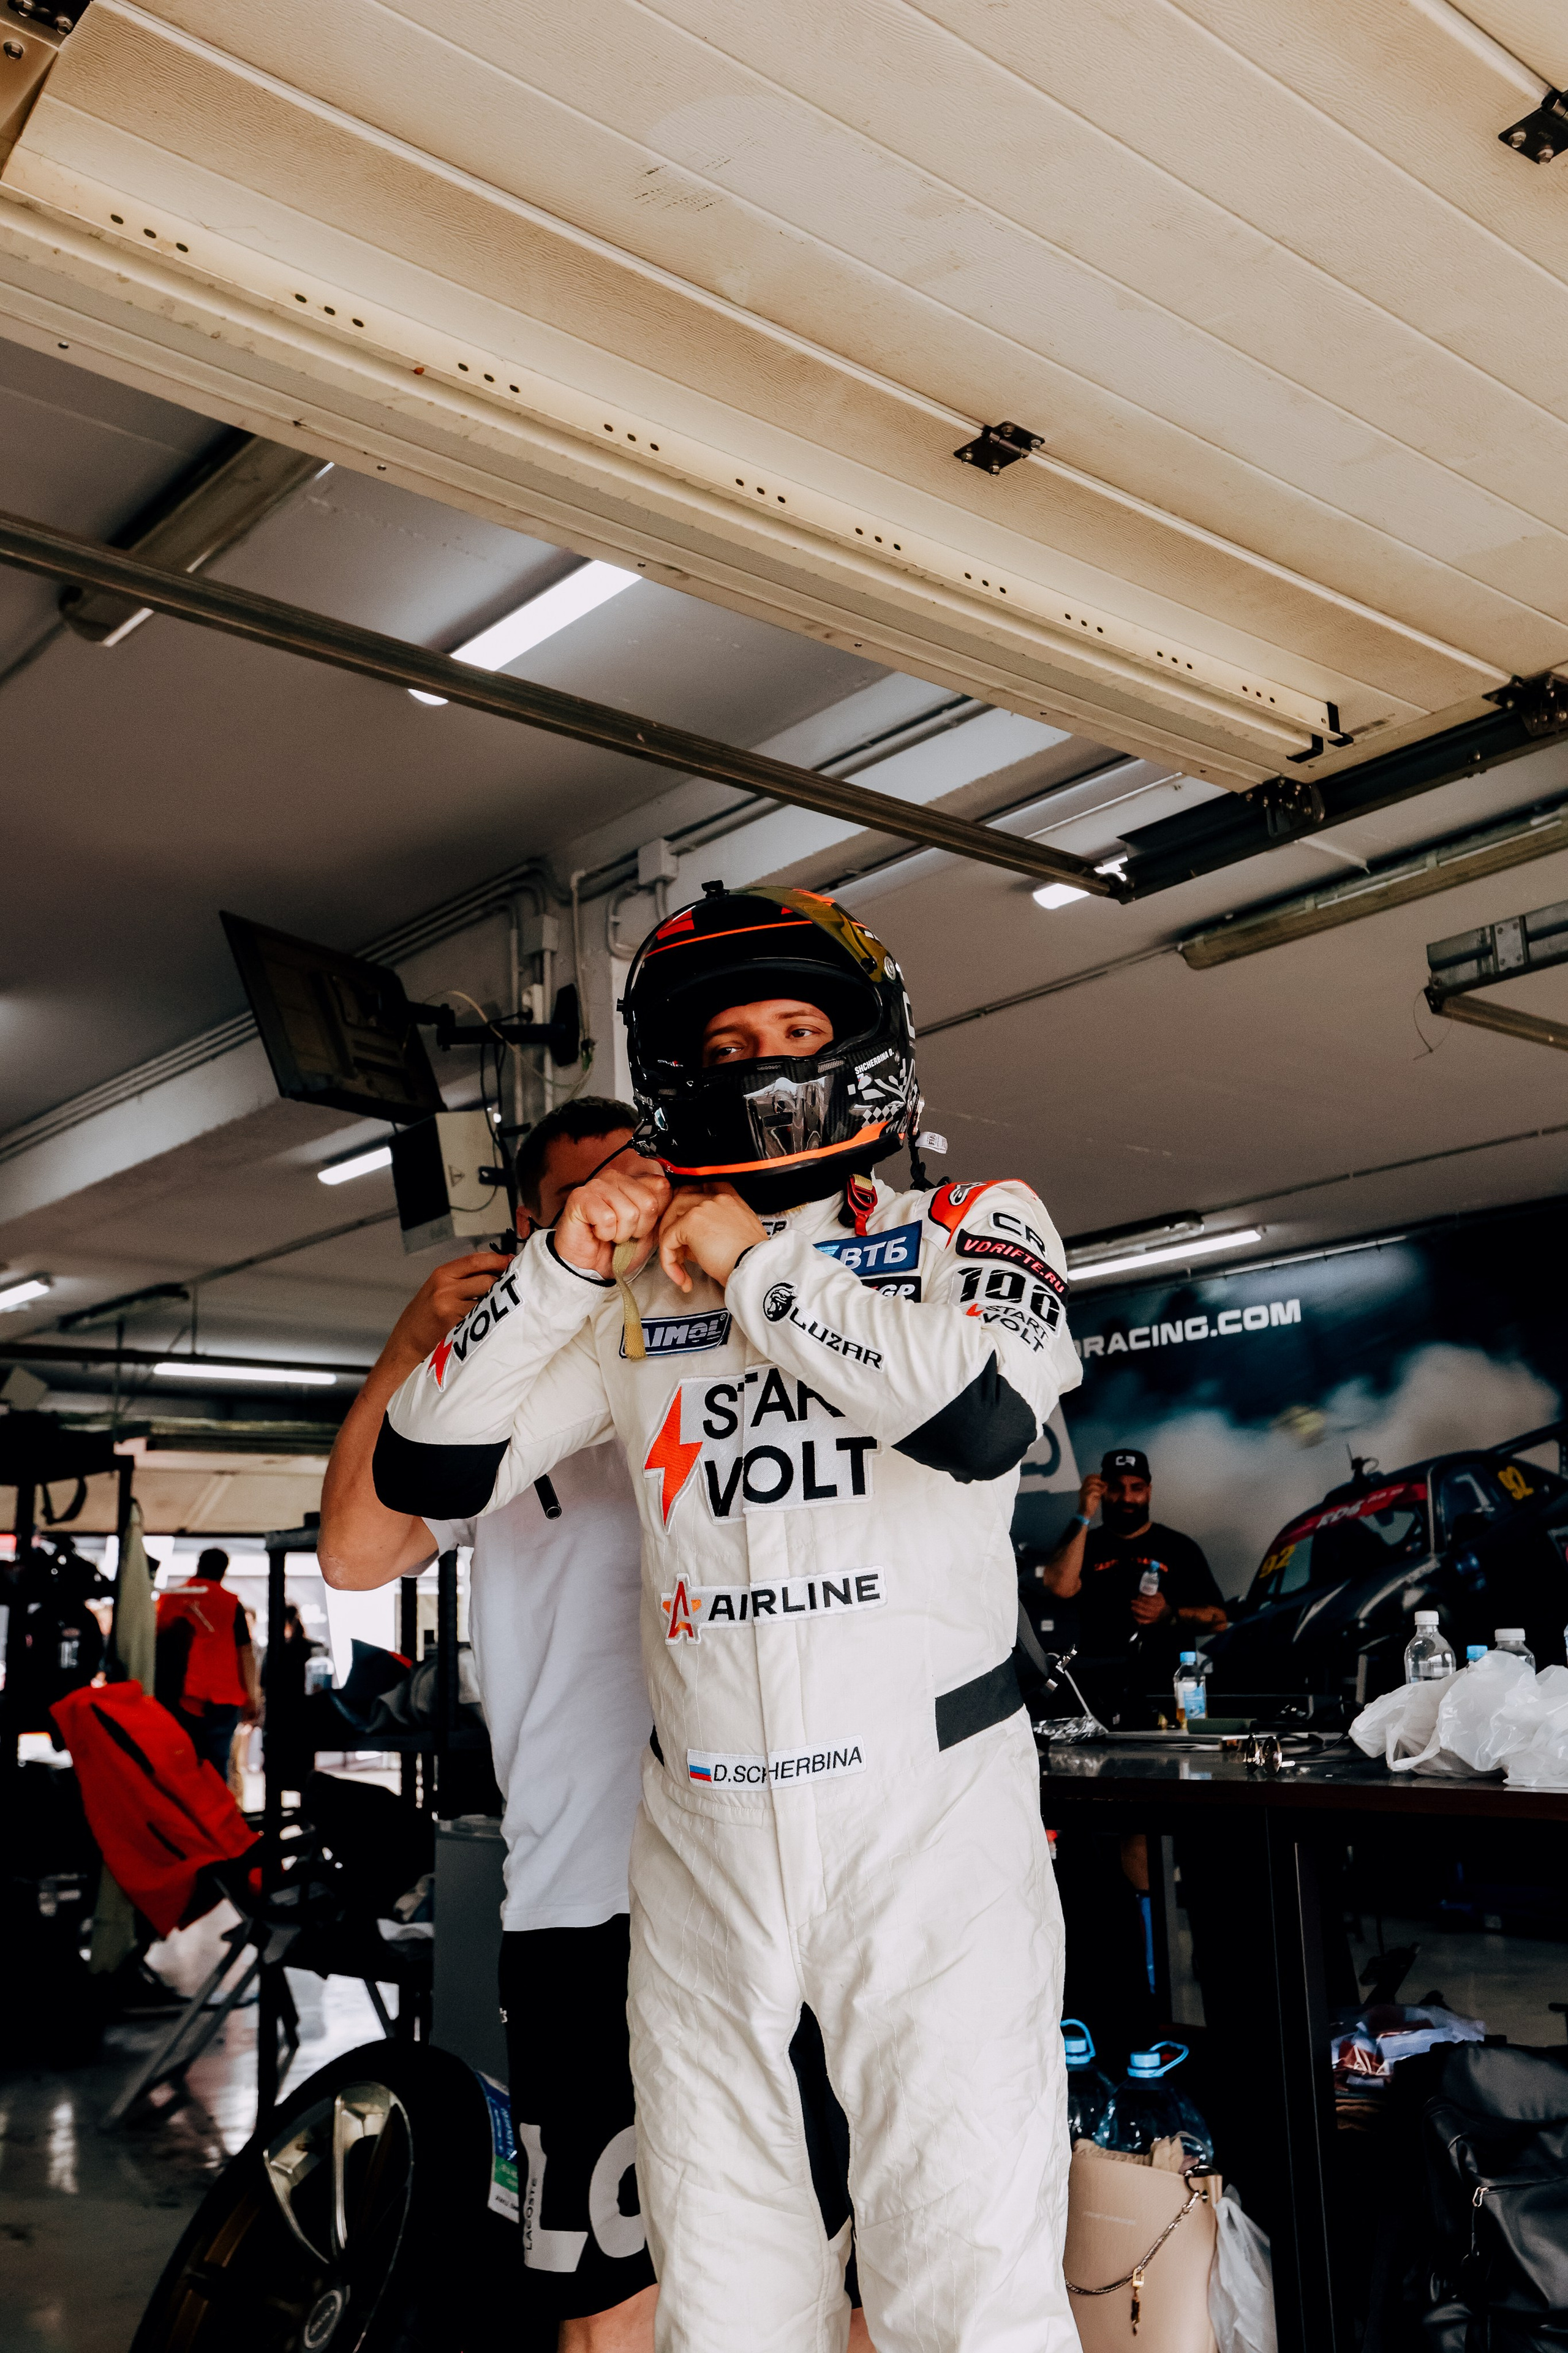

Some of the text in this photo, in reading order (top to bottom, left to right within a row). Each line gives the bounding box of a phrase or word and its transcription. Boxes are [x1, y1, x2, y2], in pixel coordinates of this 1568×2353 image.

[854, 1048, 894, 1075] SHCHERBINA D.
[839, 1236, 908, 1269] ВТБ
[993, 1212, 1046, 1258] CR
[963, 1239, 1065, 1293] VDRIFTE.RU
[453, 1274, 521, 1361] VOLT
[957, 1267, 1060, 1332] 100
[986, 1305, 1048, 1339] START
[789, 1306, 883, 1370] LUZAR
[982, 1313, 1044, 1352] VOLT
[1075, 1299, 1301, 1359] RACING.COM
[704, 1436, 878, 1517] VOLT
[708, 1574, 881, 1621] AIRLINE
[524, 2178, 537, 2251] LACOSTE
